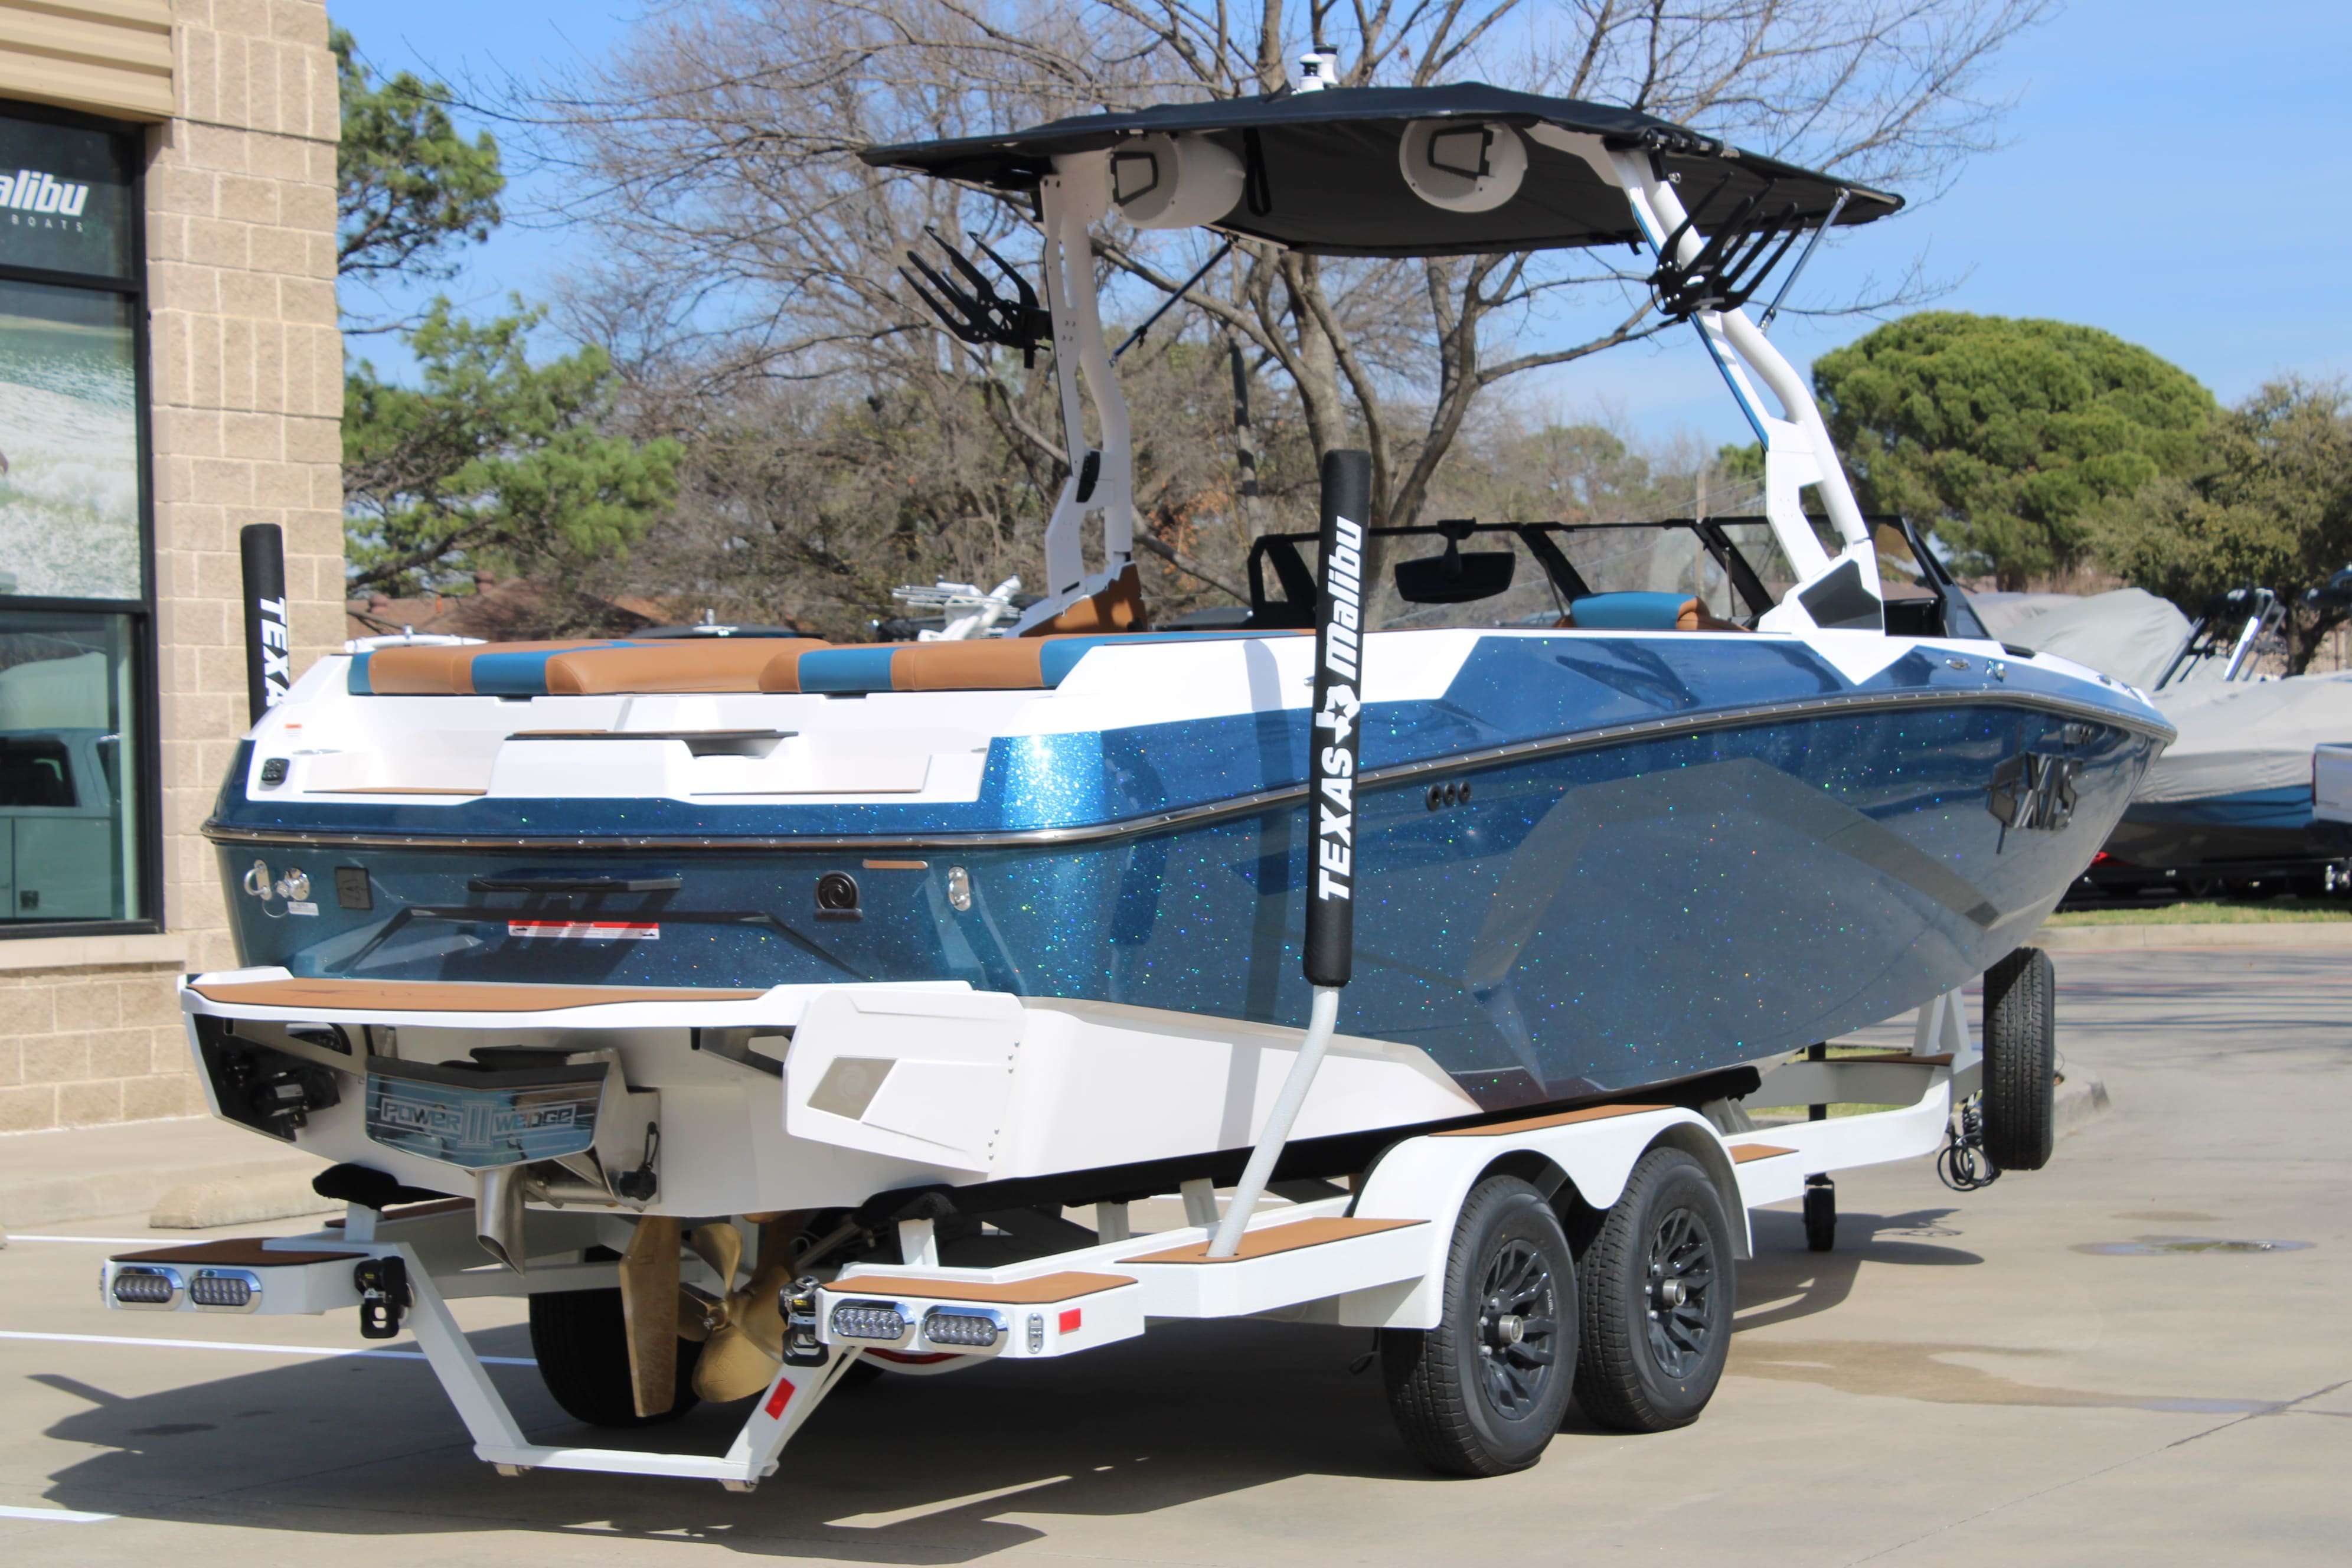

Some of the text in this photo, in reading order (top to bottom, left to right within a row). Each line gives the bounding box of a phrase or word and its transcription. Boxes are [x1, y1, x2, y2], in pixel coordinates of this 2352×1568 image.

[11, 214, 83, 233] BOATS
[1982, 749, 2085, 850] AXIS
[1318, 746, 1354, 901] TEXAS
[383, 1102, 460, 1131] POWER
[494, 1108, 573, 1132] WEDGE
[1546, 1289, 1554, 1315] FUEL
